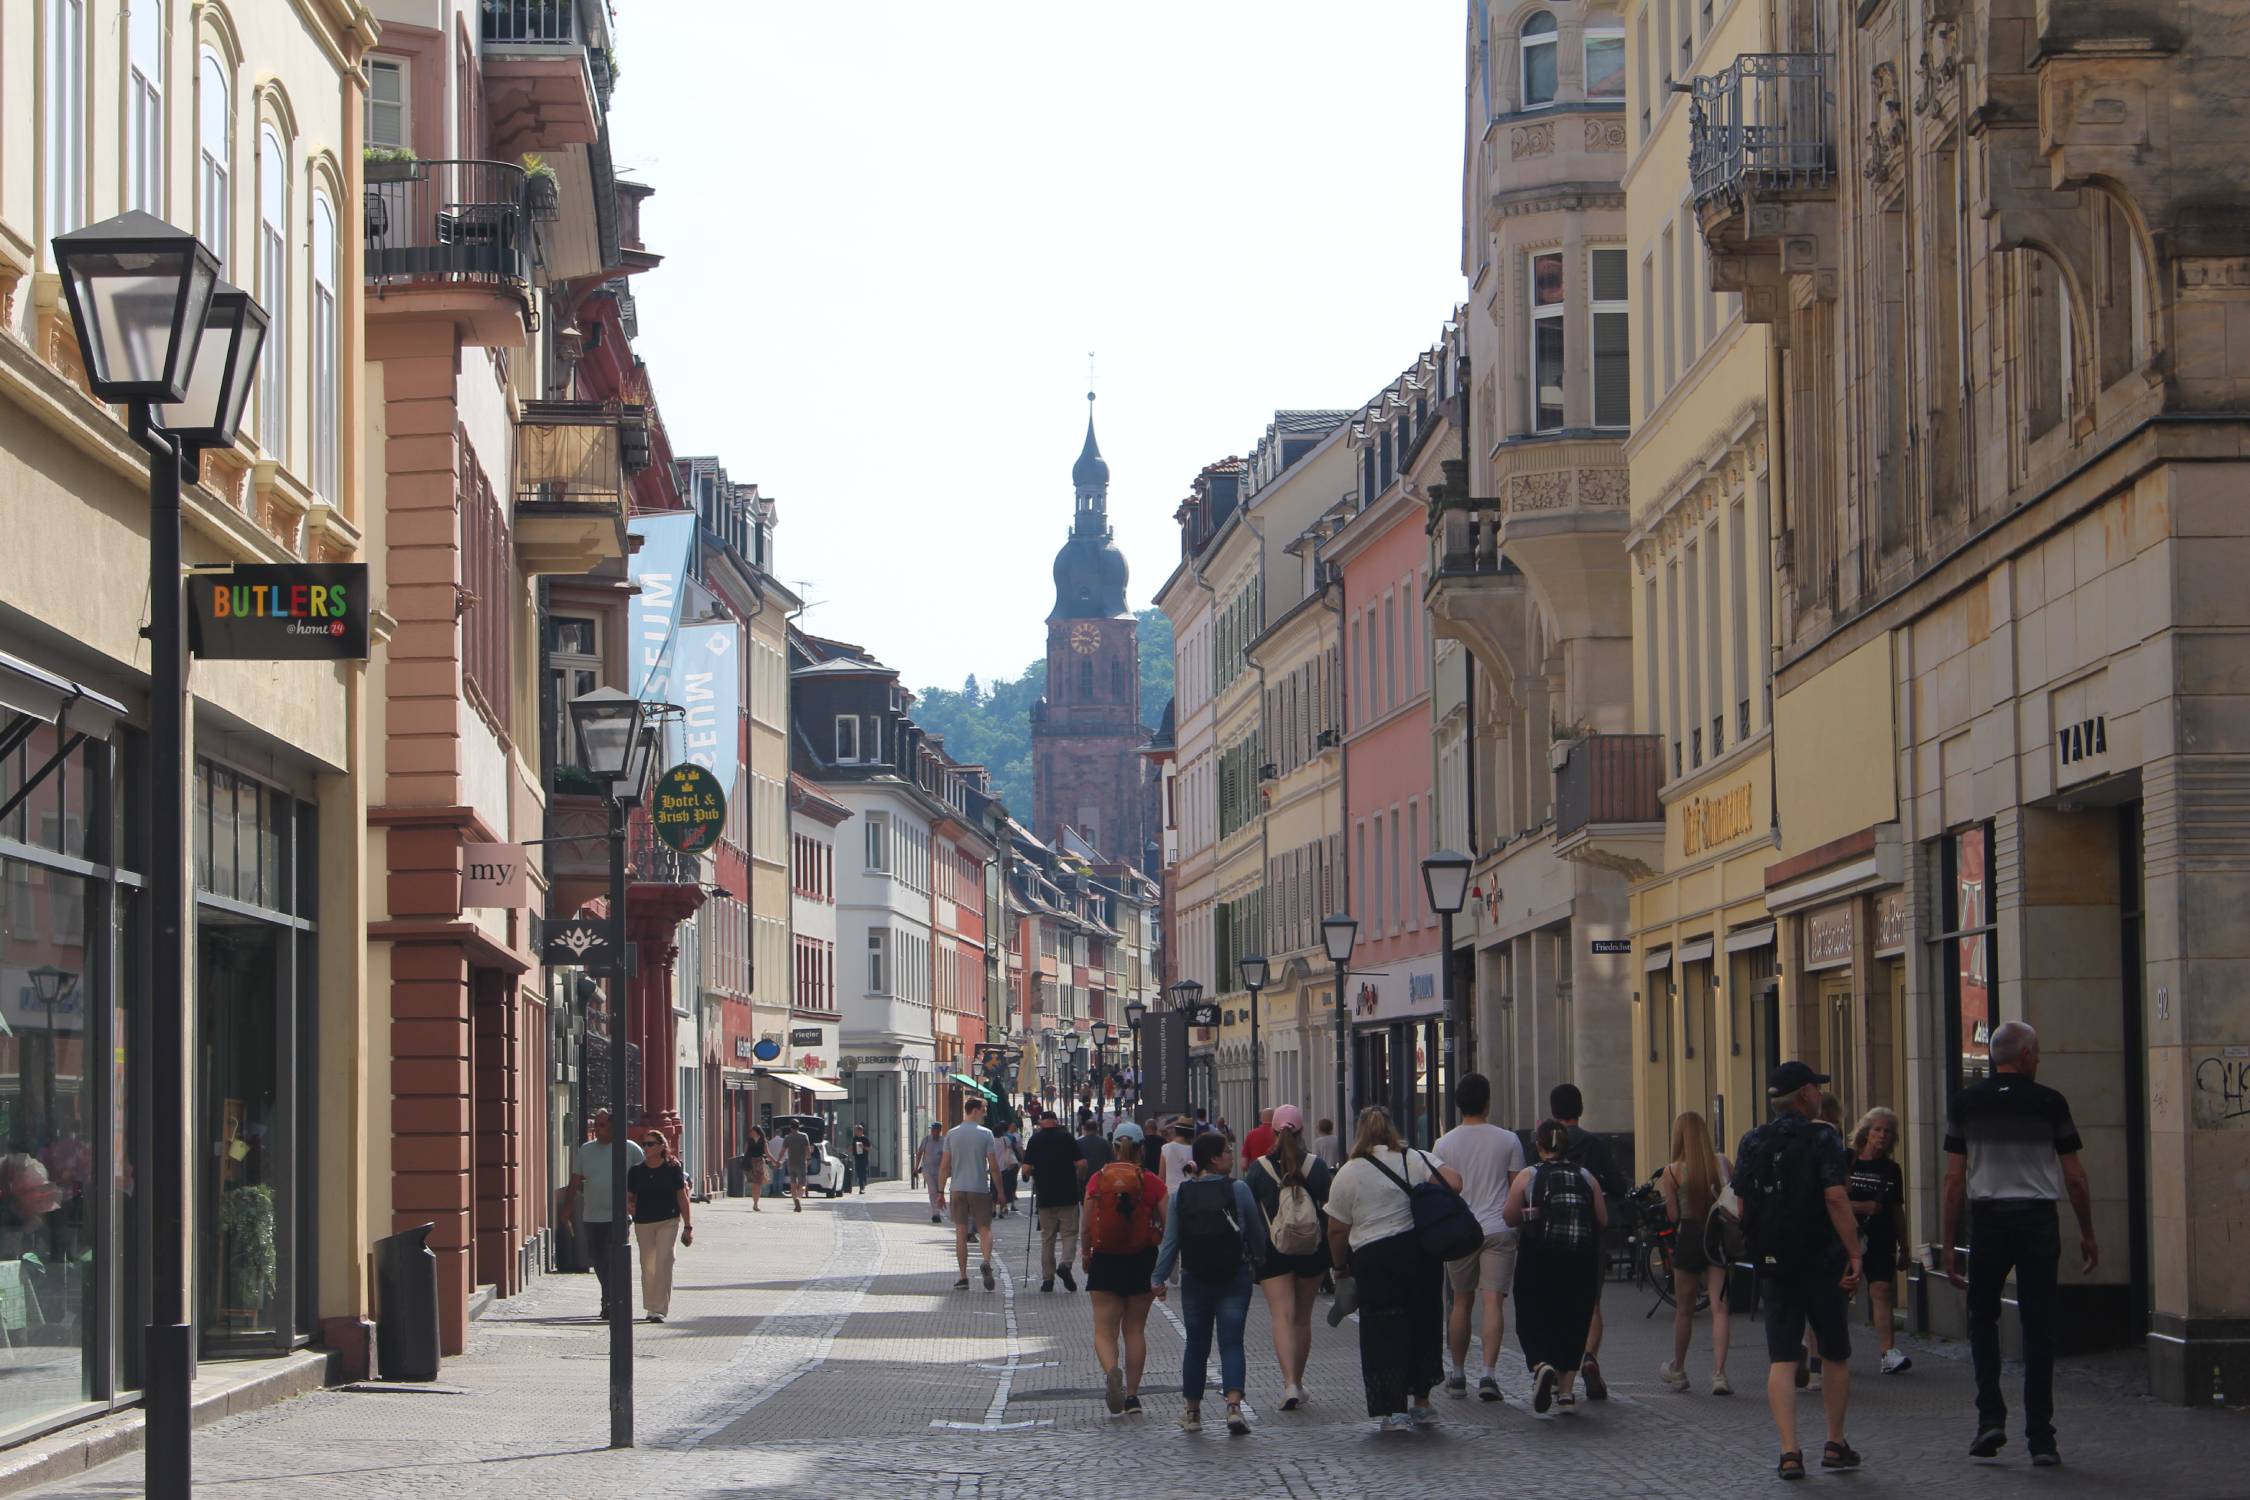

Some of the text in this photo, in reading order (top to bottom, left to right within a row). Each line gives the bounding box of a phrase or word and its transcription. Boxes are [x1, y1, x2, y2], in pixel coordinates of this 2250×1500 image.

[213, 585, 347, 617] BUTLERS
[2059, 716, 2107, 765] YAYA
[661, 793, 715, 810] Hotel &
[658, 809, 719, 823] Irish Pub
[2158, 986, 2169, 1020] 92
[795, 1031, 820, 1040] riegler
